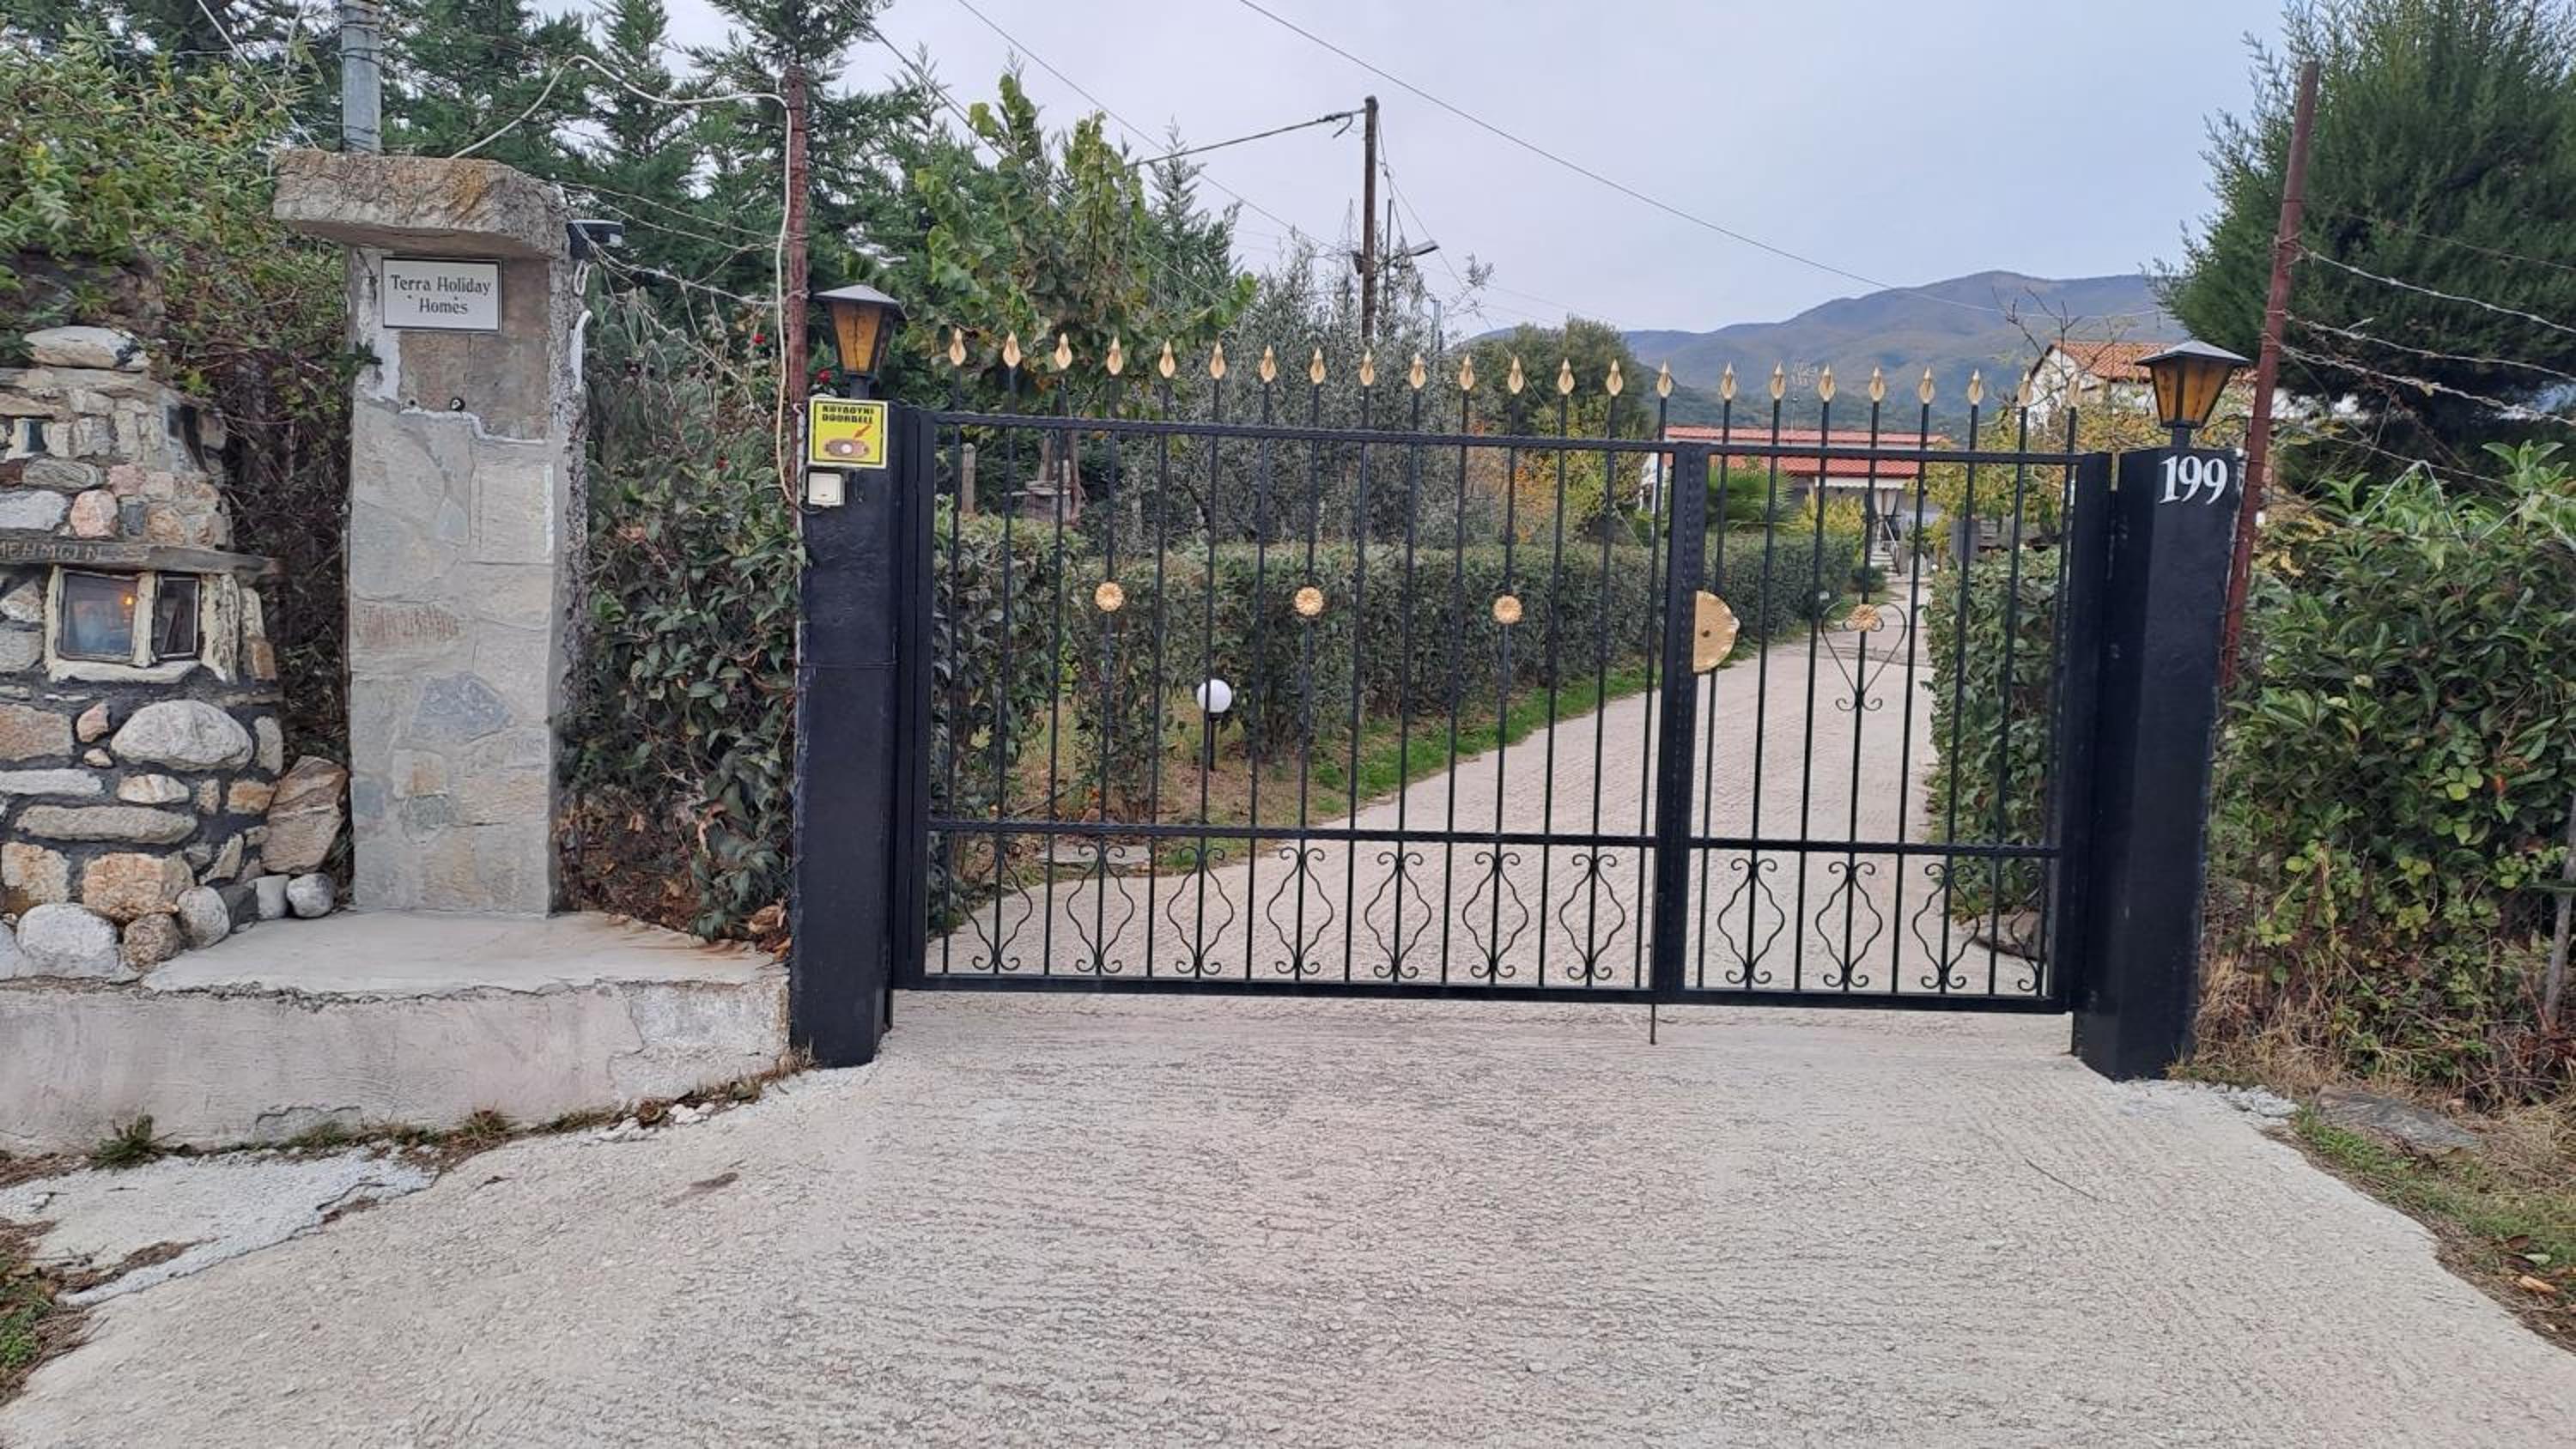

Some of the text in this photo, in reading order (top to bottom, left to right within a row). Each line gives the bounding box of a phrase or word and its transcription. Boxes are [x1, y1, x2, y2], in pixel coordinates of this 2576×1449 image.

[391, 274, 491, 295] Terra Holiday
[419, 298, 468, 315] Homes
[2159, 455, 2228, 505] 199
